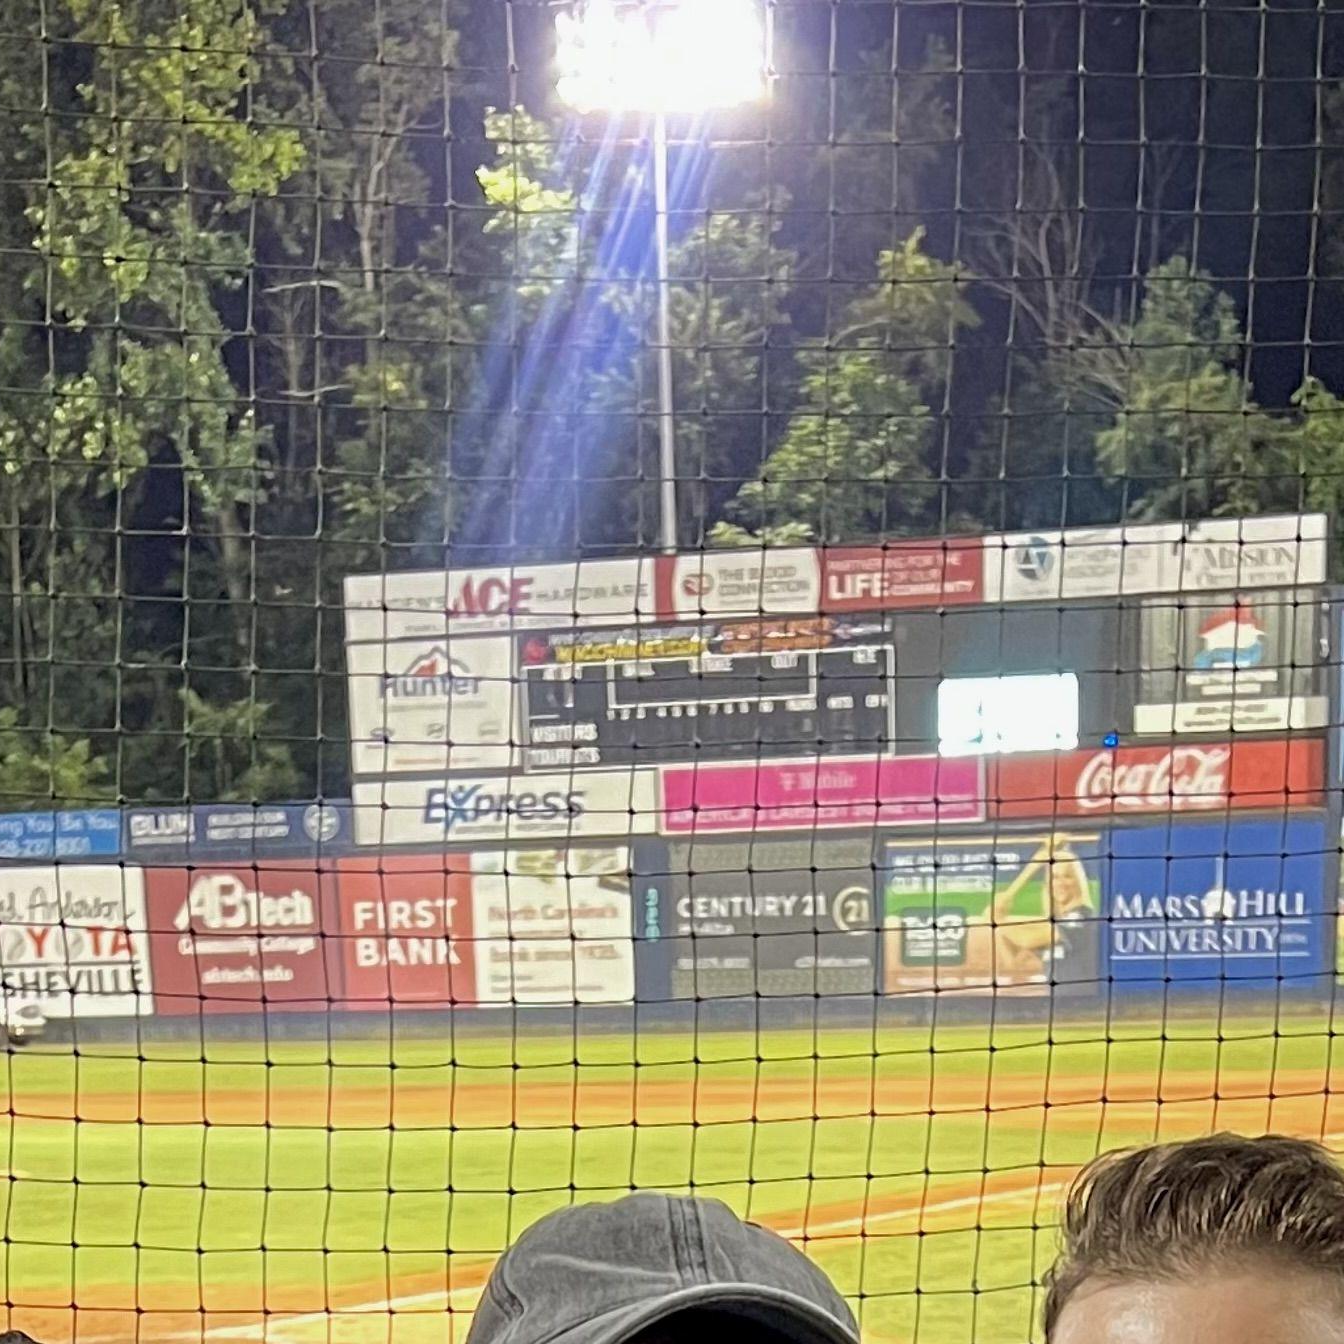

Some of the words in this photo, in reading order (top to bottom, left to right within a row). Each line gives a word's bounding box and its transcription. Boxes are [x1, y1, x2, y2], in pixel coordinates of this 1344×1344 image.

[448, 575, 534, 618] ACE
[828, 572, 889, 600] LIFE
[380, 677, 480, 698] Hunter
[353, 898, 458, 930] FIRST
[676, 897, 798, 919] CENTURY
[801, 895, 827, 916] 21
[1112, 892, 1201, 918] MARS
[355, 936, 462, 967] BANK
[1113, 926, 1279, 953] UNIVERSITY
